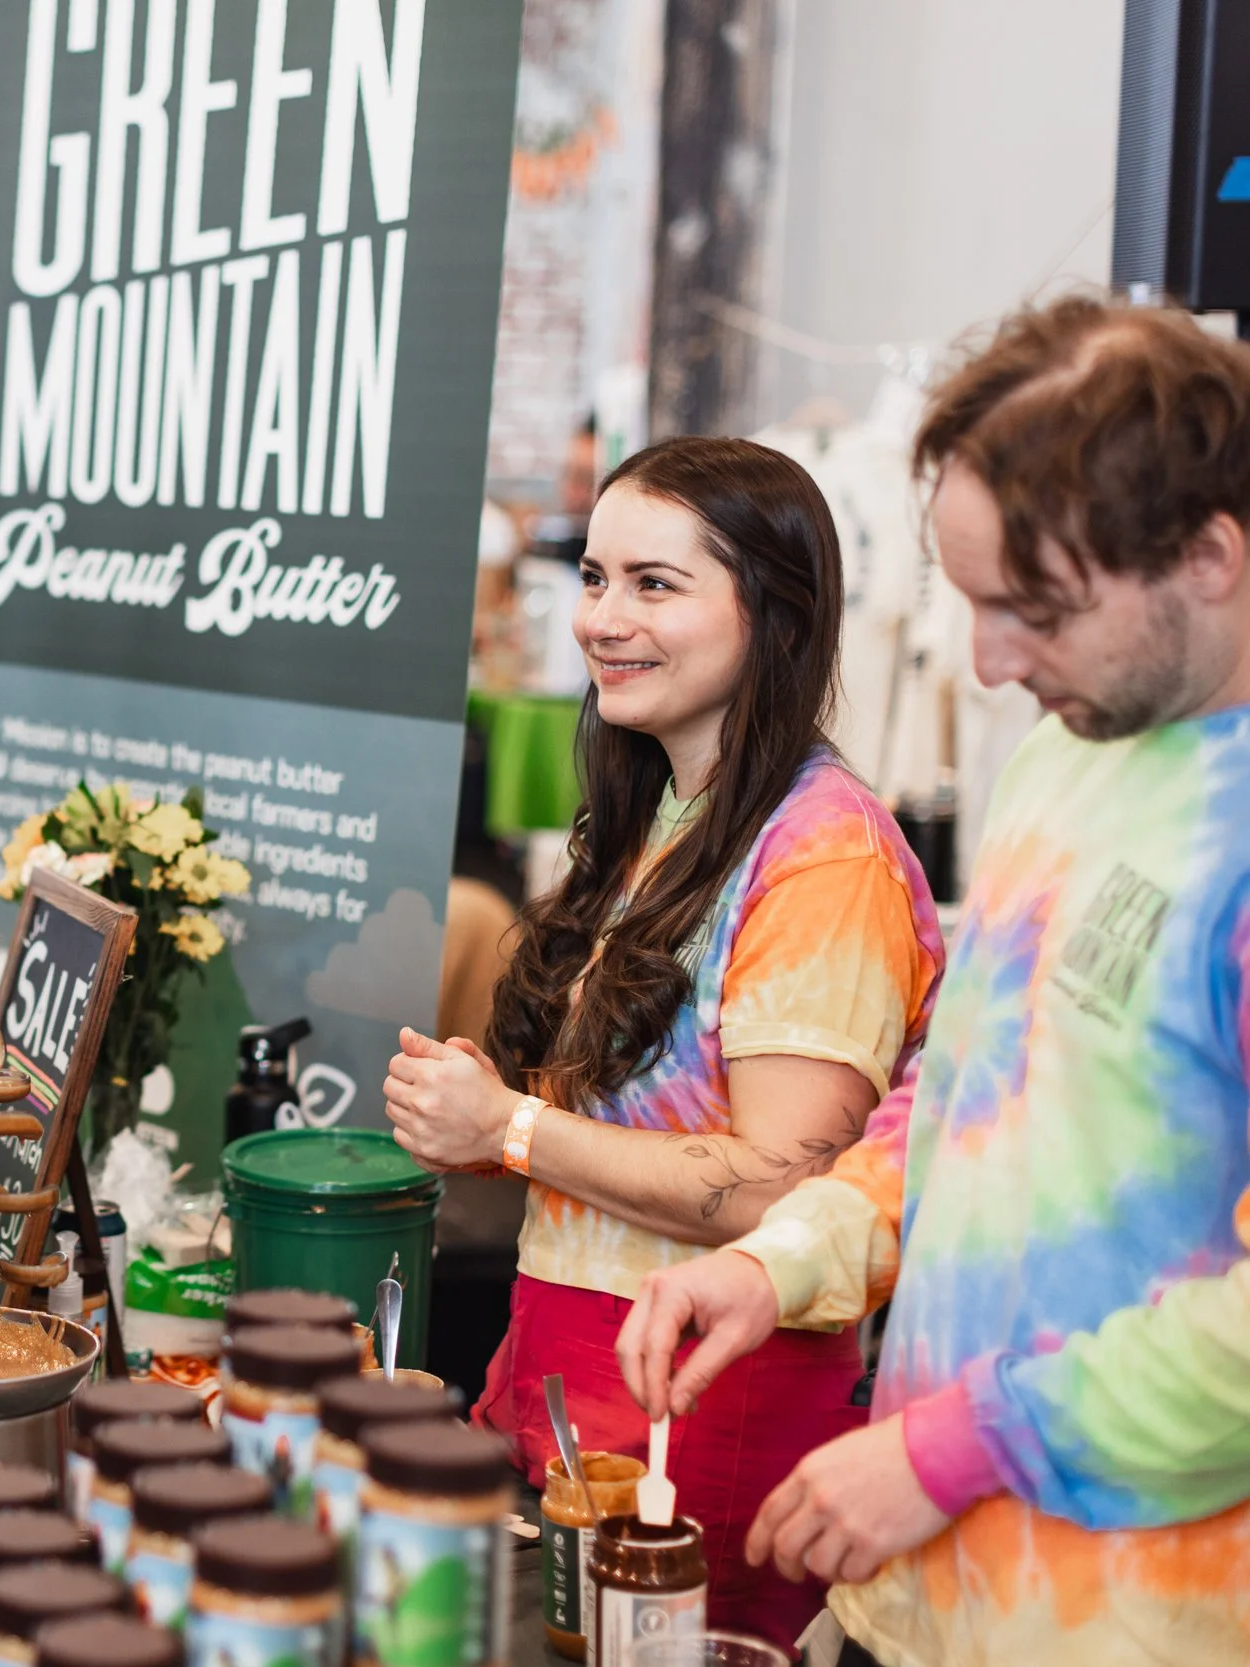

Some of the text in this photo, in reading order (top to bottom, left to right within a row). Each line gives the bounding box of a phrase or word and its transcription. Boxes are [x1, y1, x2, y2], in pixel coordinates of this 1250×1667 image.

[12, 0, 427, 297] GREEN
[185, 517, 401, 637] Butter
[171, 741, 201, 774] the
[203, 753, 272, 786] peanut
[277, 757, 345, 795] butter
[204, 785, 248, 821] local
[252, 793, 332, 835] farmers
[336, 812, 377, 842] and
[254, 834, 368, 883] ingredients
[258, 877, 331, 921] always
[336, 889, 368, 922] for
[6, 940, 88, 1075] SALE
